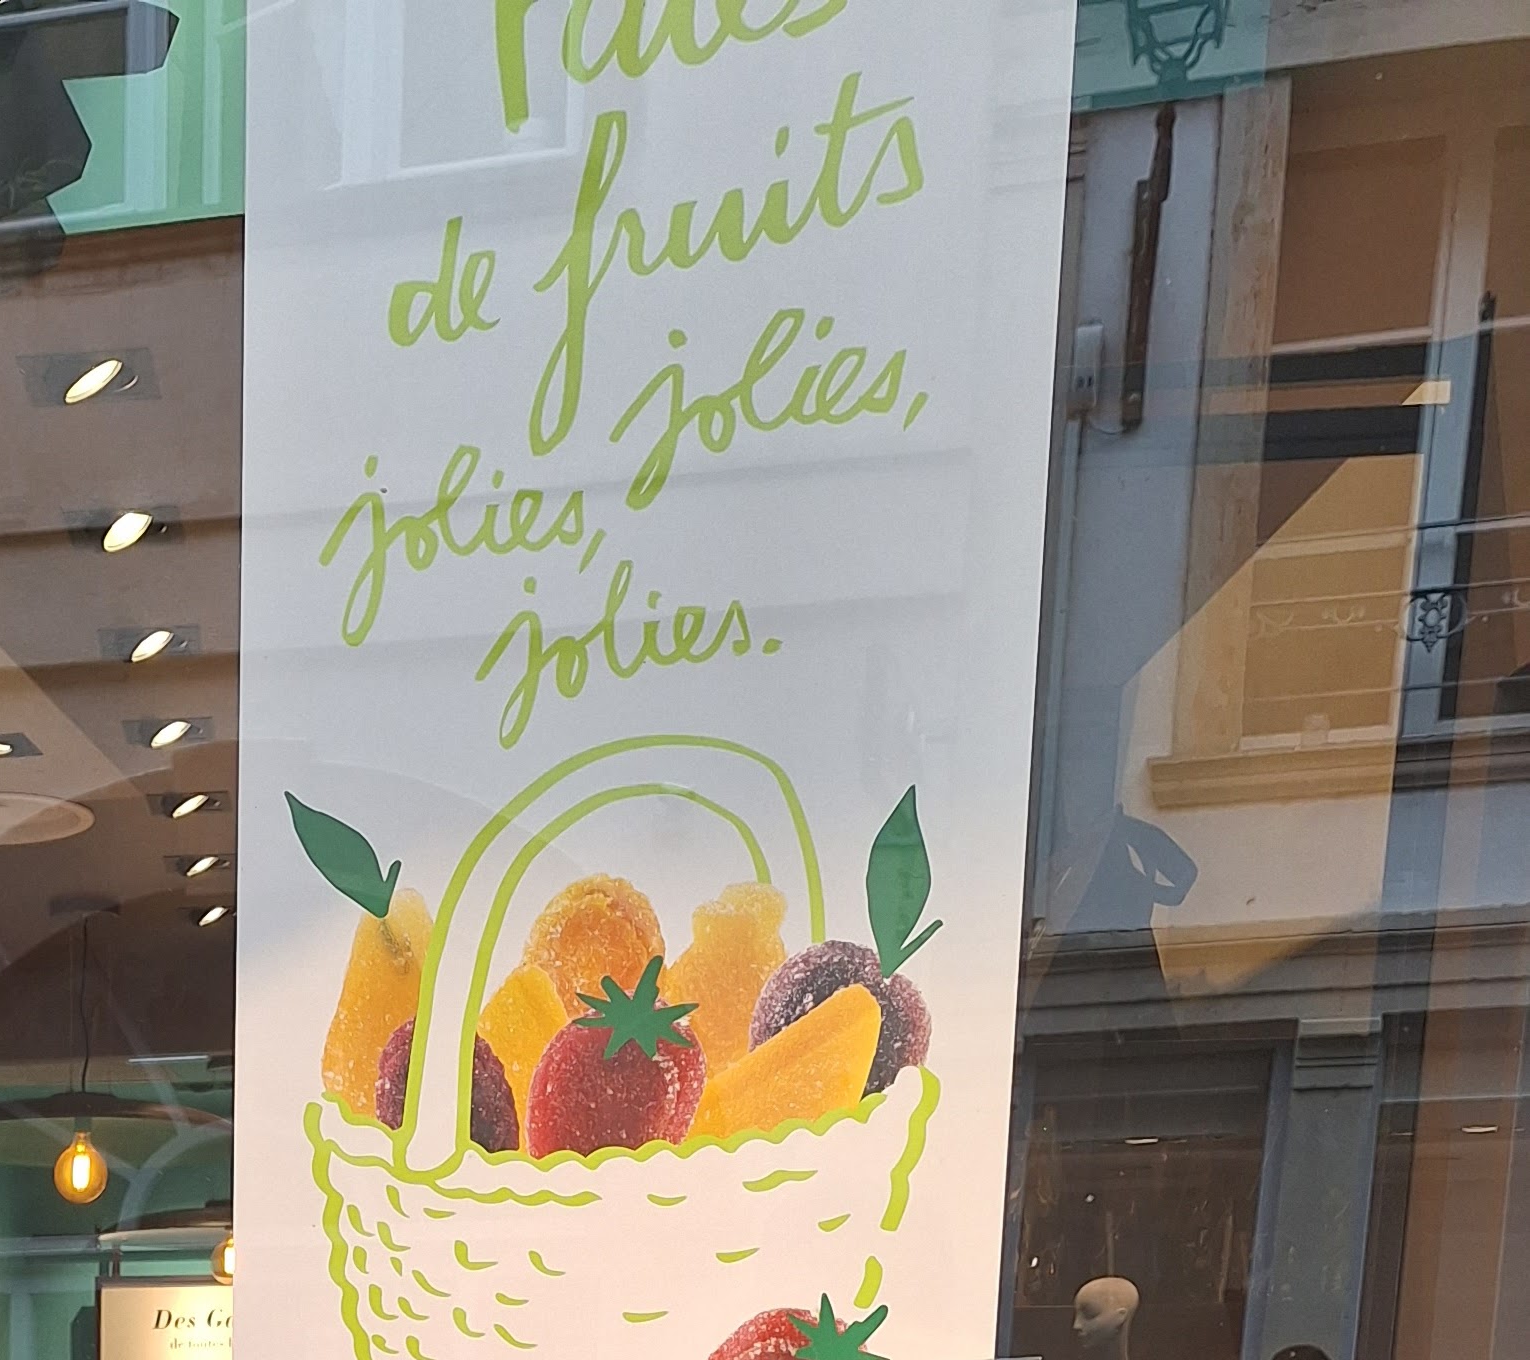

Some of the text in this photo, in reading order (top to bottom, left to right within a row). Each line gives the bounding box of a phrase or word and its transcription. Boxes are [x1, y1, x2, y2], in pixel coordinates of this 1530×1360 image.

[388, 70, 925, 457] de fruits
[609, 307, 928, 511] jolies,
[319, 444, 608, 647] jolies,
[474, 559, 784, 750] jolies.
[152, 1308, 196, 1330] Des
